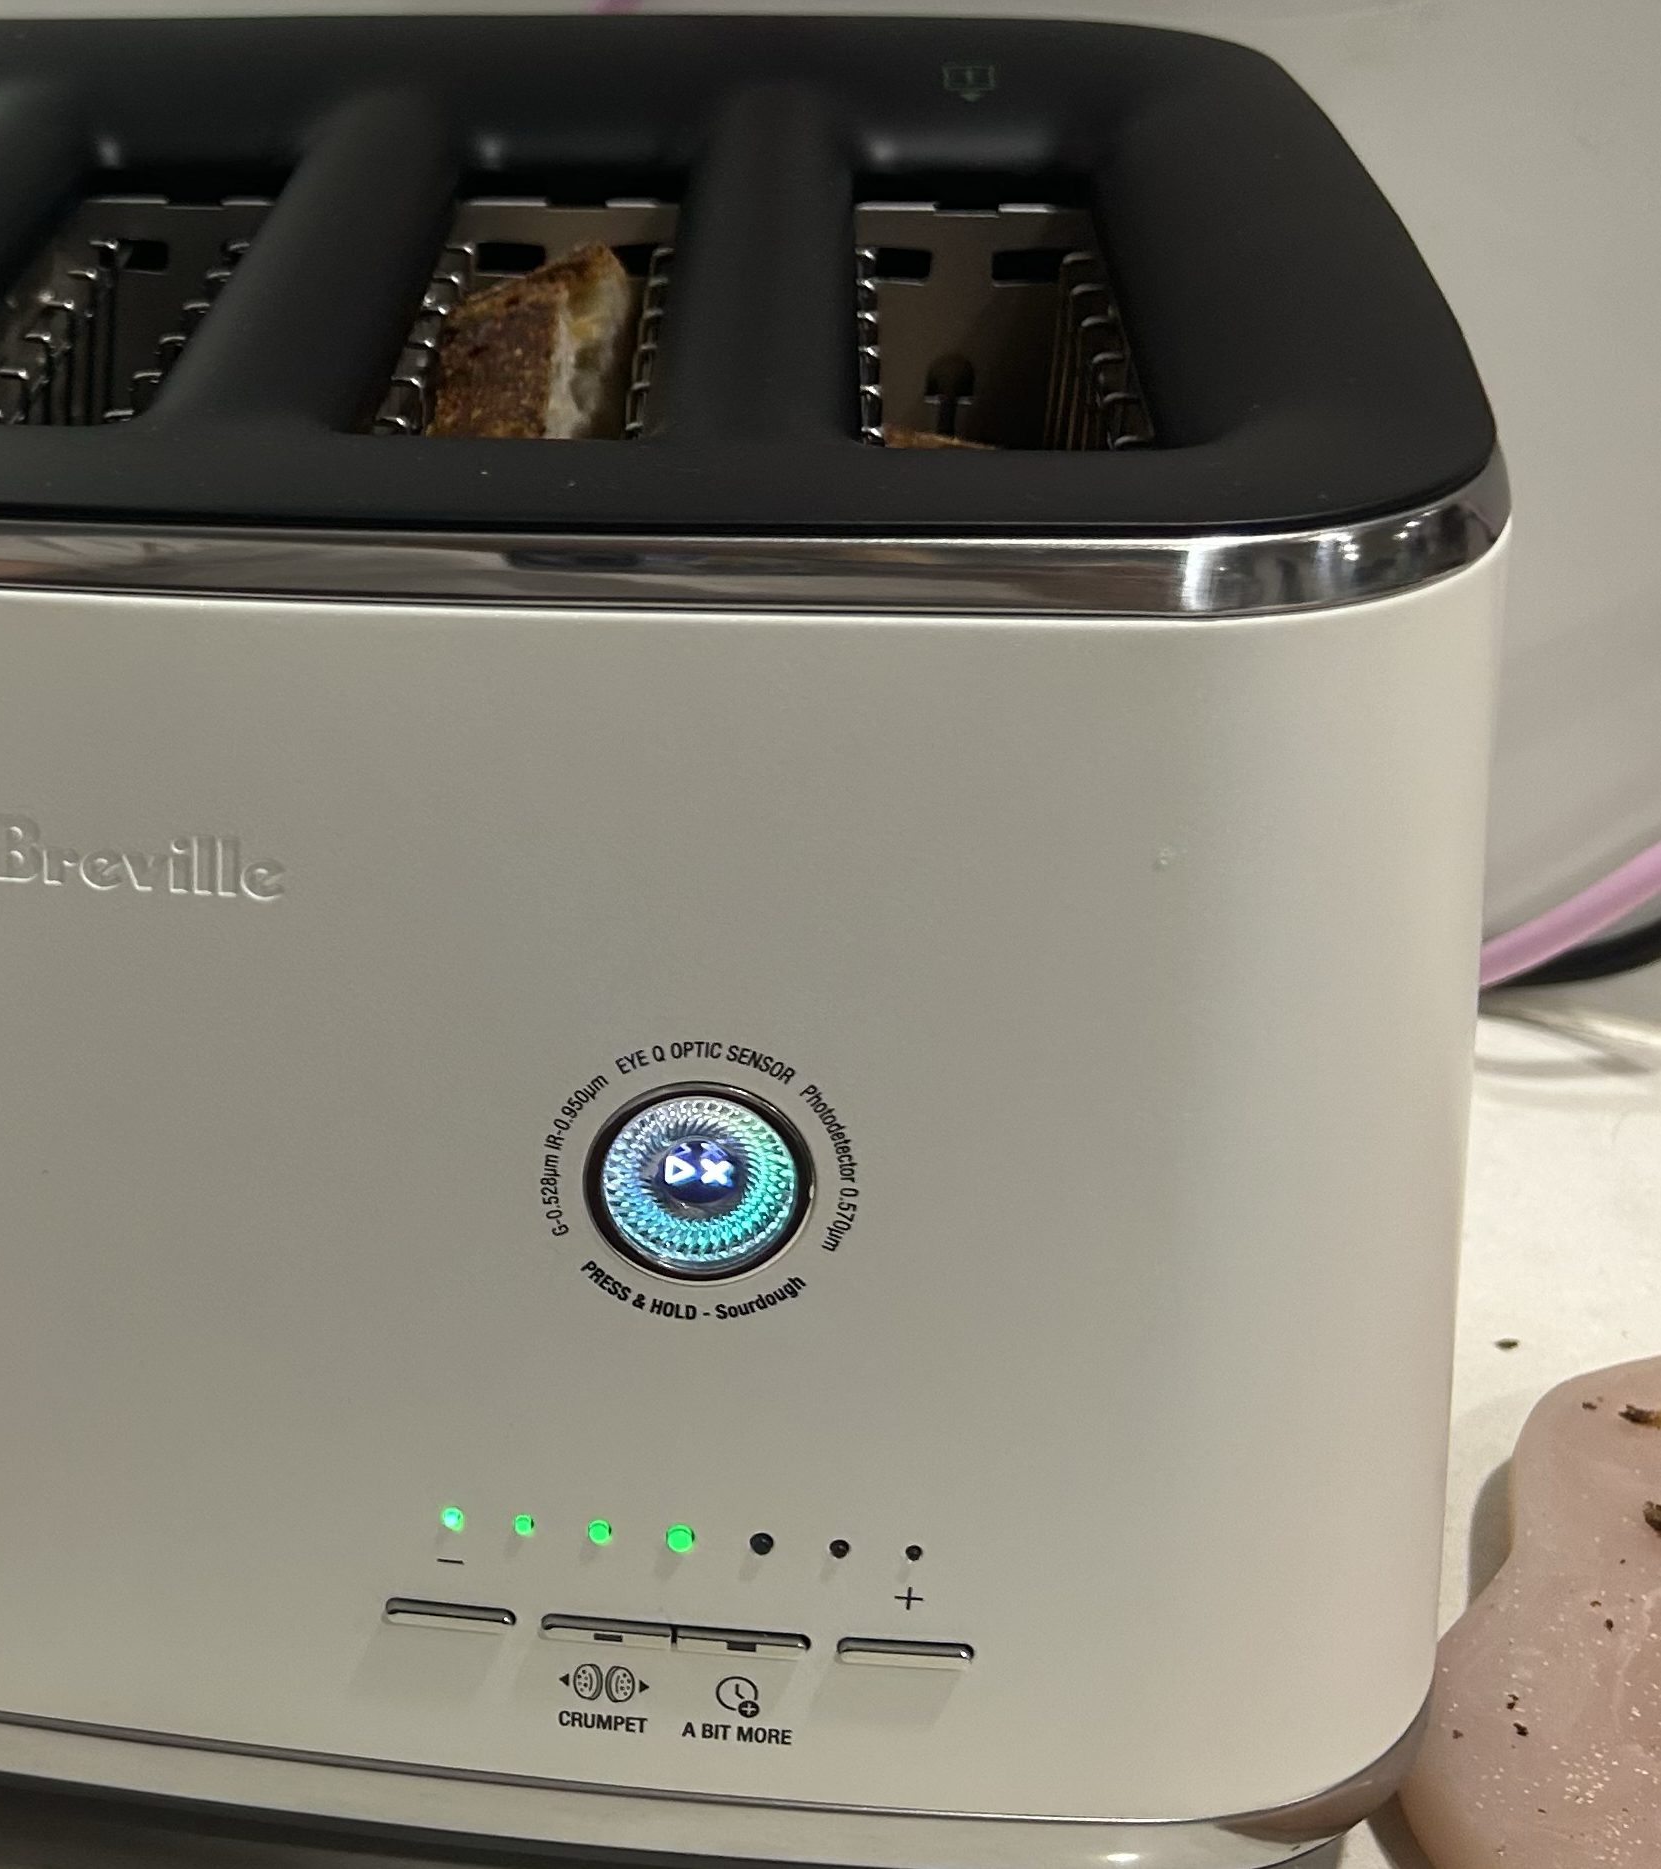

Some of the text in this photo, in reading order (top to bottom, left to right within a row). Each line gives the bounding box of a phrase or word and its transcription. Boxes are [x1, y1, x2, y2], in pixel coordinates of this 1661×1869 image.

[615, 1041, 796, 1085] EYE Q OPTIC SENSOR
[799, 1084, 858, 1183] Photodetector
[580, 1260, 632, 1302] PRESS
[632, 1293, 645, 1310] &
[649, 1298, 697, 1320] HOLD
[715, 1274, 807, 1320] Sourdough
[558, 1710, 648, 1734] CRUMPET
[681, 1722, 793, 1746] A BIT MORE
